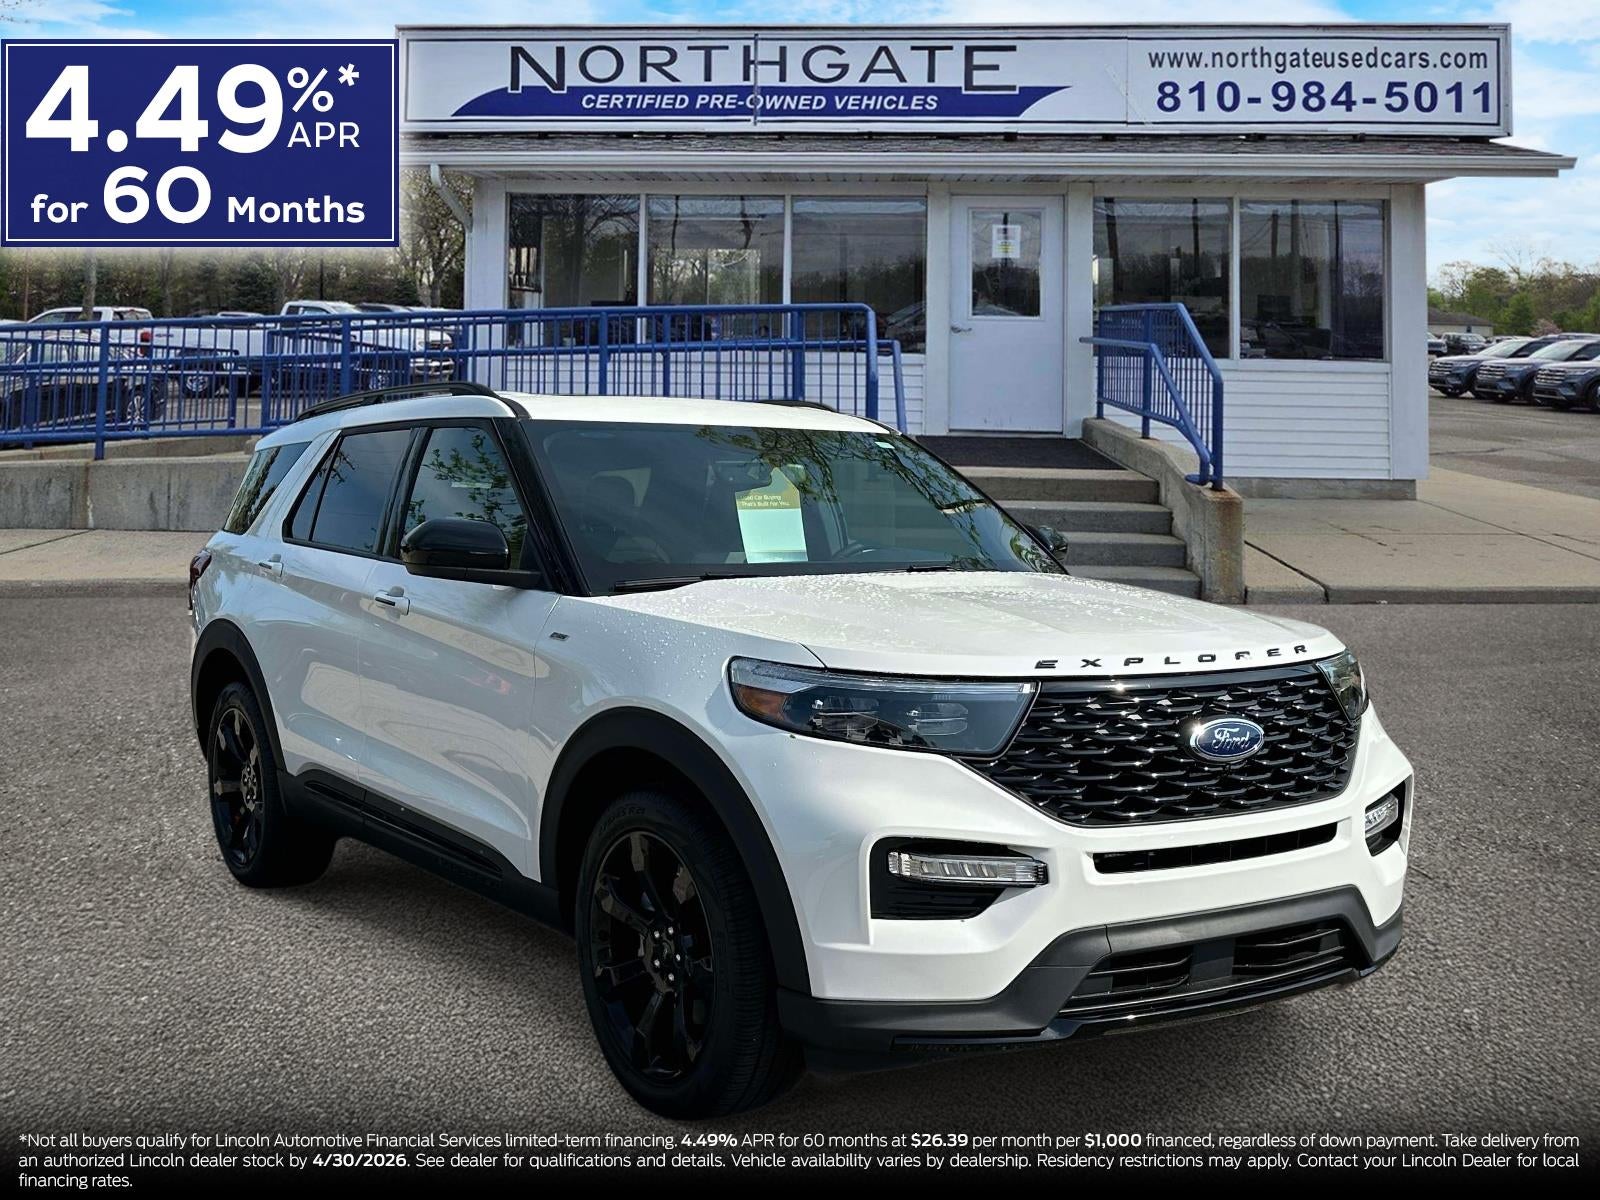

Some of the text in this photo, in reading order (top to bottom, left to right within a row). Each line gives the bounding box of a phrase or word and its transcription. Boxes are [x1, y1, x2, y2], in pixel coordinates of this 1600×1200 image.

[508, 45, 1018, 92] NORTHGATE
[1149, 47, 1488, 73] www.northgateusedcars.com
[581, 93, 939, 111] CERTIFIED PRE-OWNED VEHICLES
[1157, 81, 1491, 113] 810-984-5011
[1034, 644, 1308, 669] EXPLORER
[1211, 727, 1251, 751] Ford
